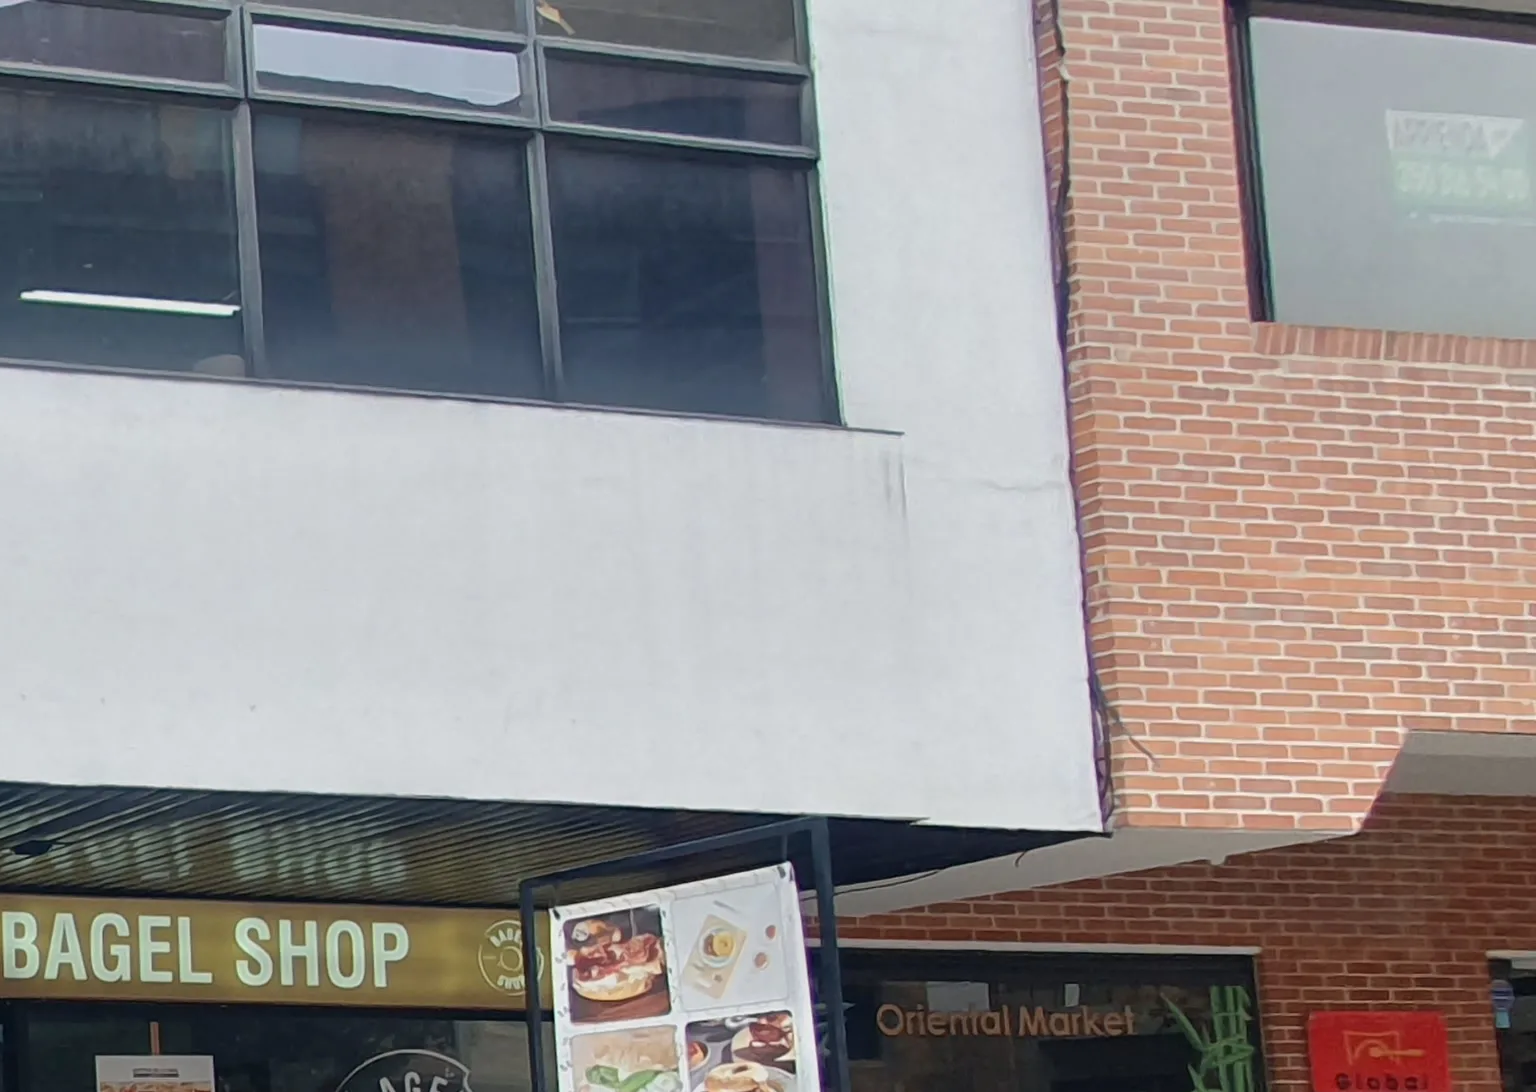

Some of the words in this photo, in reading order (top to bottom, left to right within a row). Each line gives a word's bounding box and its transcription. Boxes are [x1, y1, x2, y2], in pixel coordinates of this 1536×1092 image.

[1, 911, 213, 984] BAGEL
[234, 917, 410, 988] SHOP
[877, 1004, 1011, 1036] Oriental
[1019, 1005, 1139, 1037] Market
